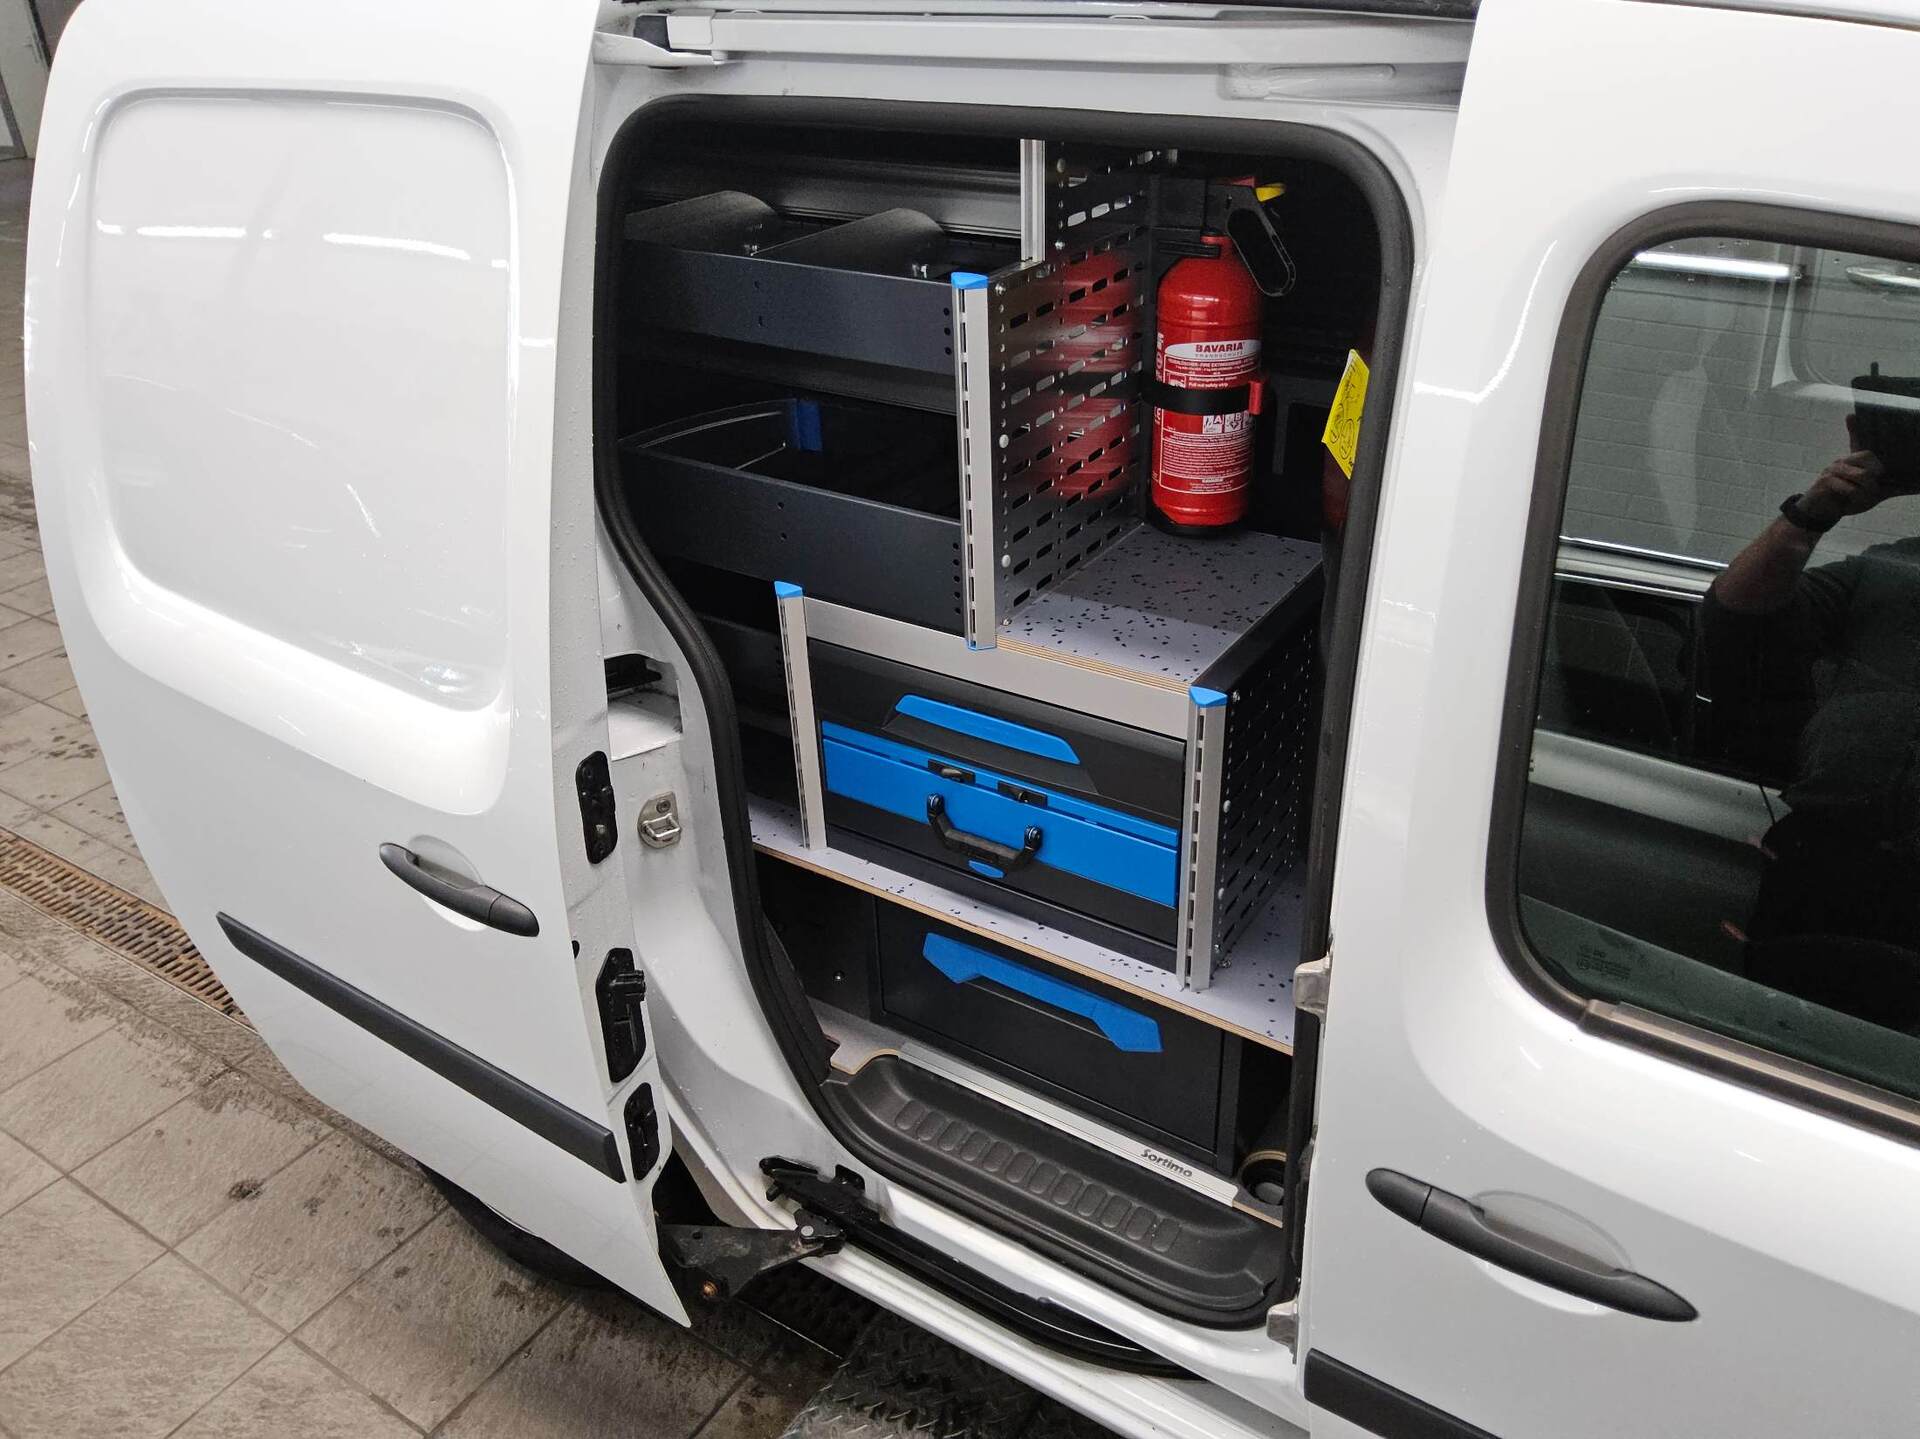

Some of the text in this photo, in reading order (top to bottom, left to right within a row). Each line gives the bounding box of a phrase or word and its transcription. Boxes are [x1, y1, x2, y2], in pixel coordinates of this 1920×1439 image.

[1195, 342, 1244, 353] BAVARIA
[1213, 415, 1222, 424] A
[1140, 1148, 1193, 1178] Sortimo
